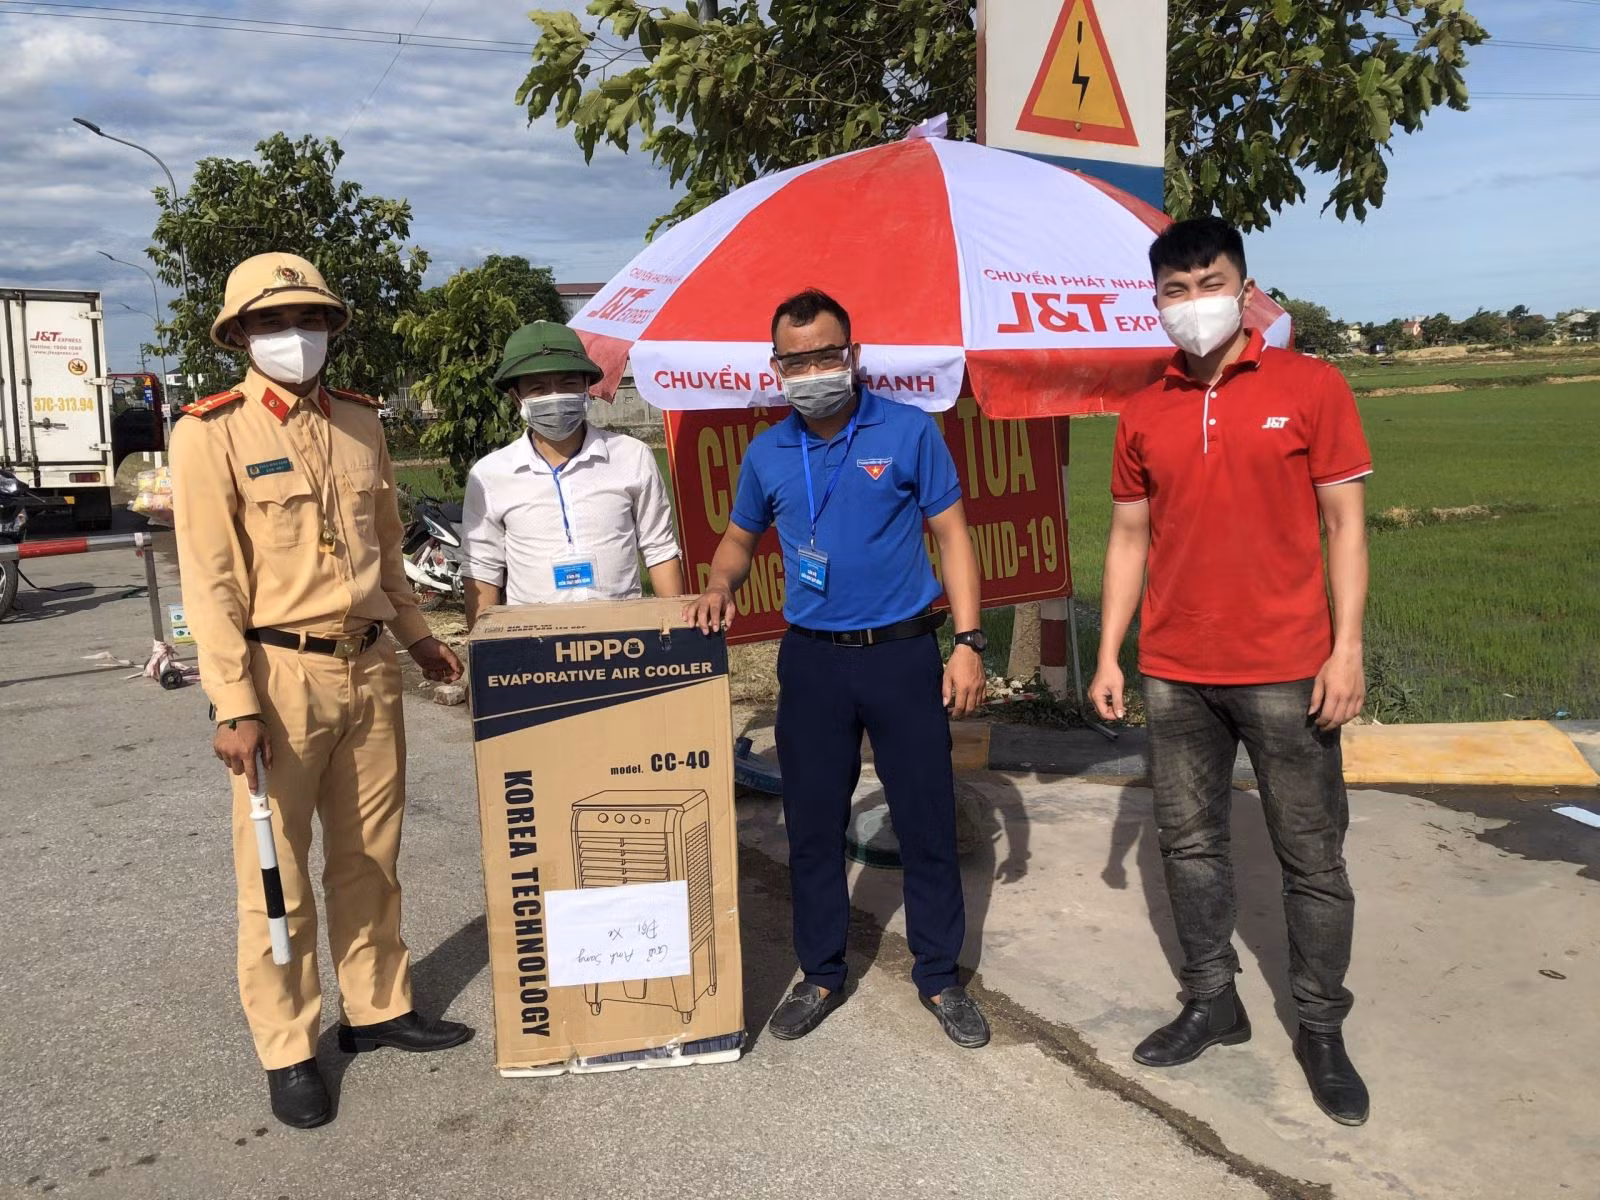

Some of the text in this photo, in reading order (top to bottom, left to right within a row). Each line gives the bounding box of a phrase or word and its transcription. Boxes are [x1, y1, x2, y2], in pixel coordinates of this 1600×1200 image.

[984, 269, 1157, 290] CHUYỂN PHÁT NHAN
[997, 291, 1120, 333] J&T
[30, 331, 63, 342] J&T
[654, 364, 752, 391] CHUYỂN
[857, 374, 936, 393] HANH
[34, 397, 94, 411] 37C-313.94
[1261, 416, 1290, 429] J&T
[967, 515, 1058, 581] VID-19
[555, 637, 645, 663] HIPPO
[487, 662, 713, 688] EVAPORATIVE AIR COOLER
[610, 749, 711, 776] model. CC-40
[503, 769, 551, 1038] KOREA TECHNOLOGY
